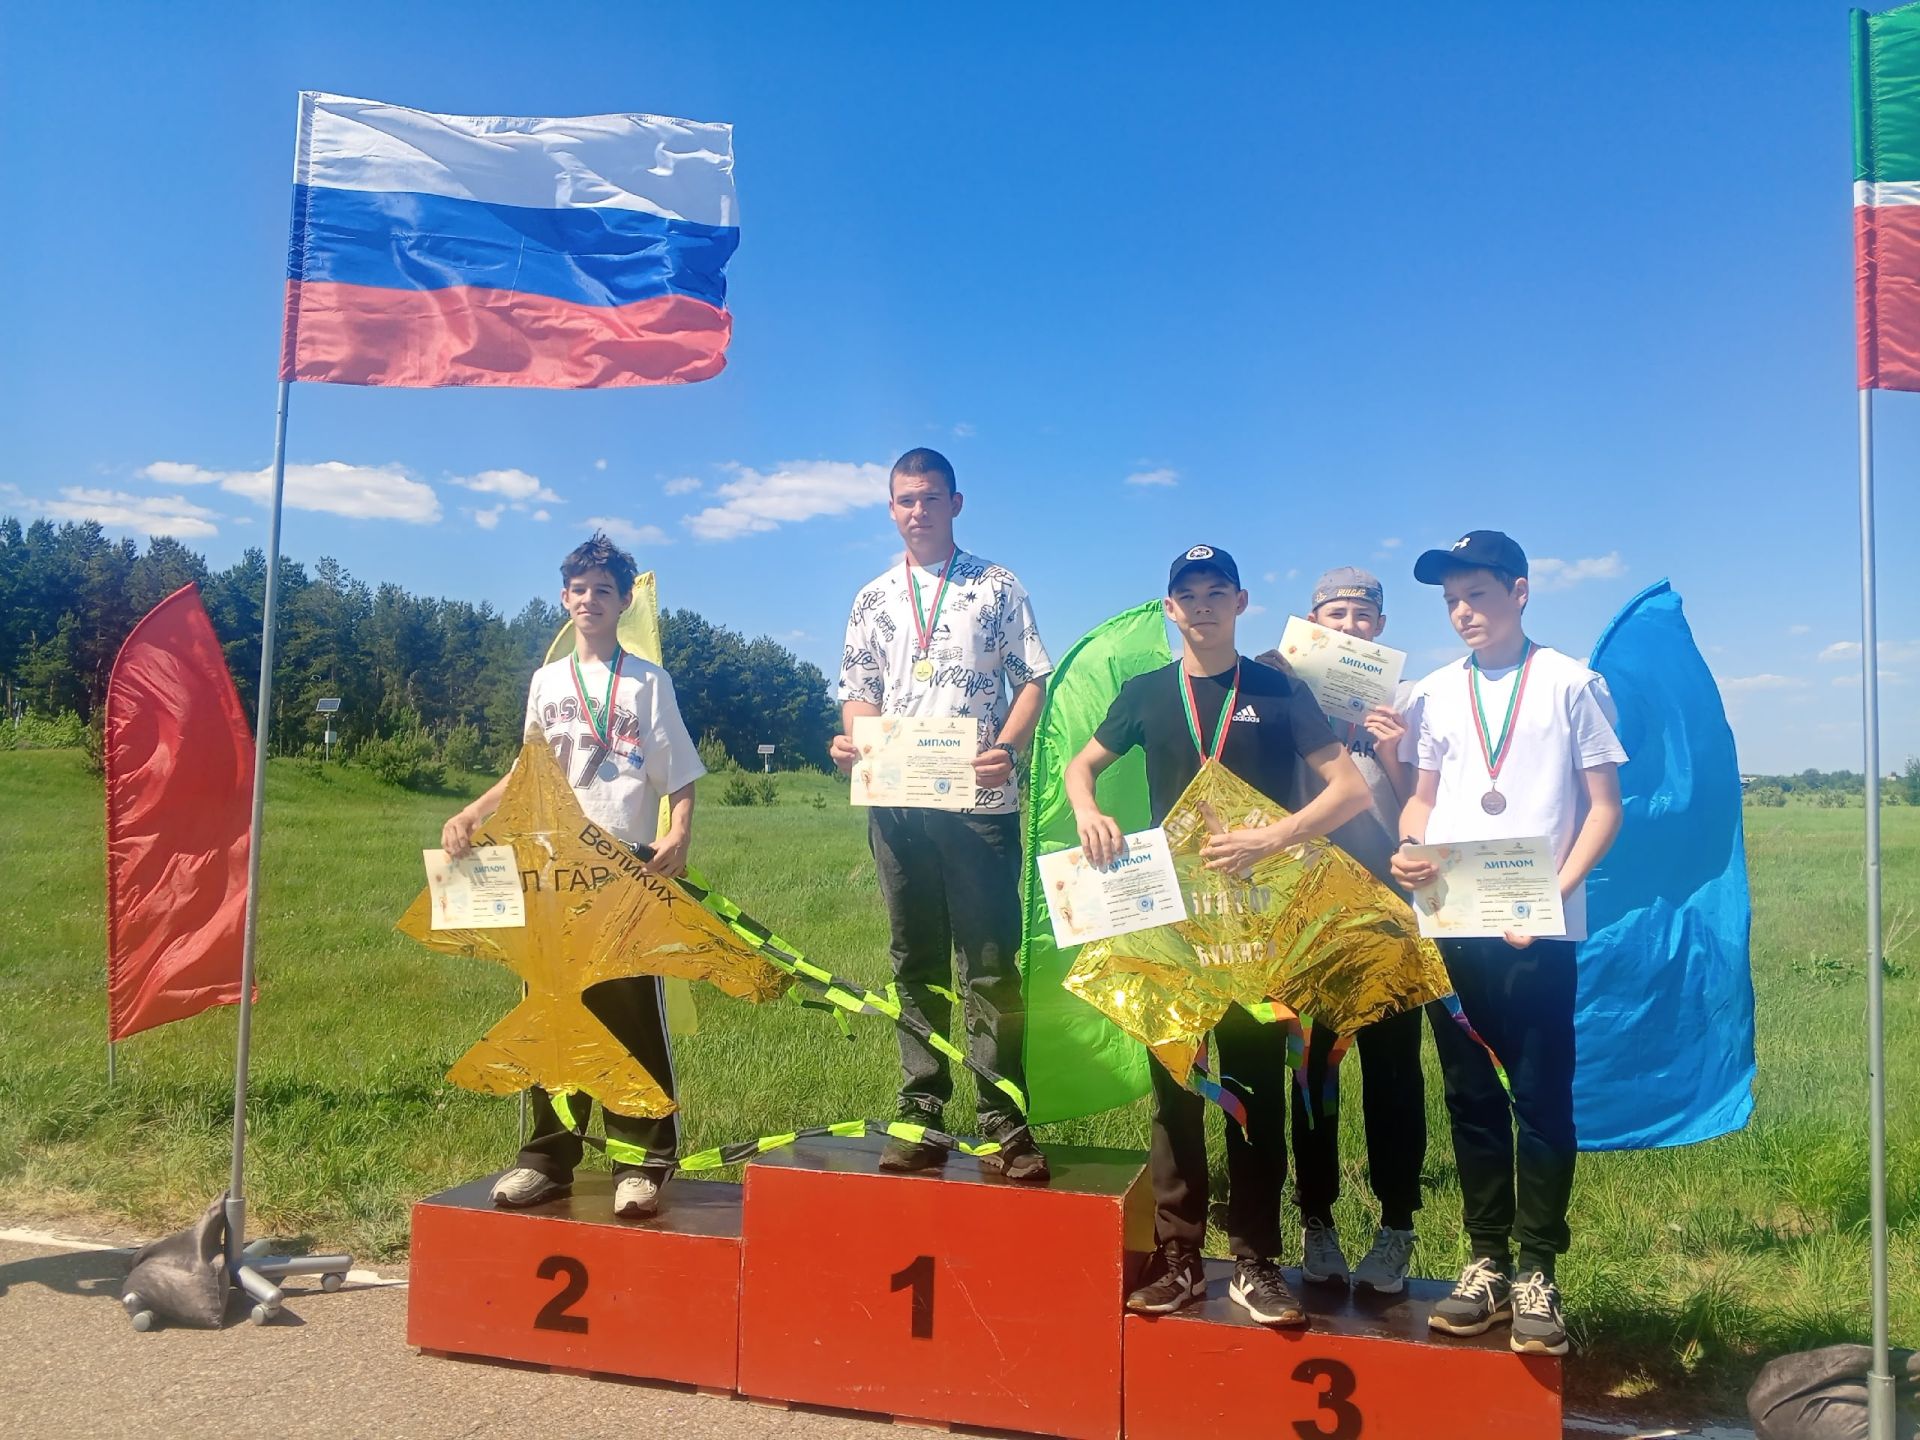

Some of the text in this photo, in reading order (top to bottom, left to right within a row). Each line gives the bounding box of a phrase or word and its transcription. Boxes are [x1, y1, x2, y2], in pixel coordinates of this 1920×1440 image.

[1338, 656, 1383, 675] ДИПЛОМ
[1232, 714, 1260, 723] adidas
[917, 739, 961, 747] ДИПЛОМ
[578, 823, 678, 907] Великих
[1109, 853, 1152, 870] ДИПЛОМ
[1484, 859, 1534, 869] ДИПЛОМ
[533, 1255, 589, 1334] 2
[890, 1255, 935, 1340] 1
[1291, 1358, 1363, 1440] 3
